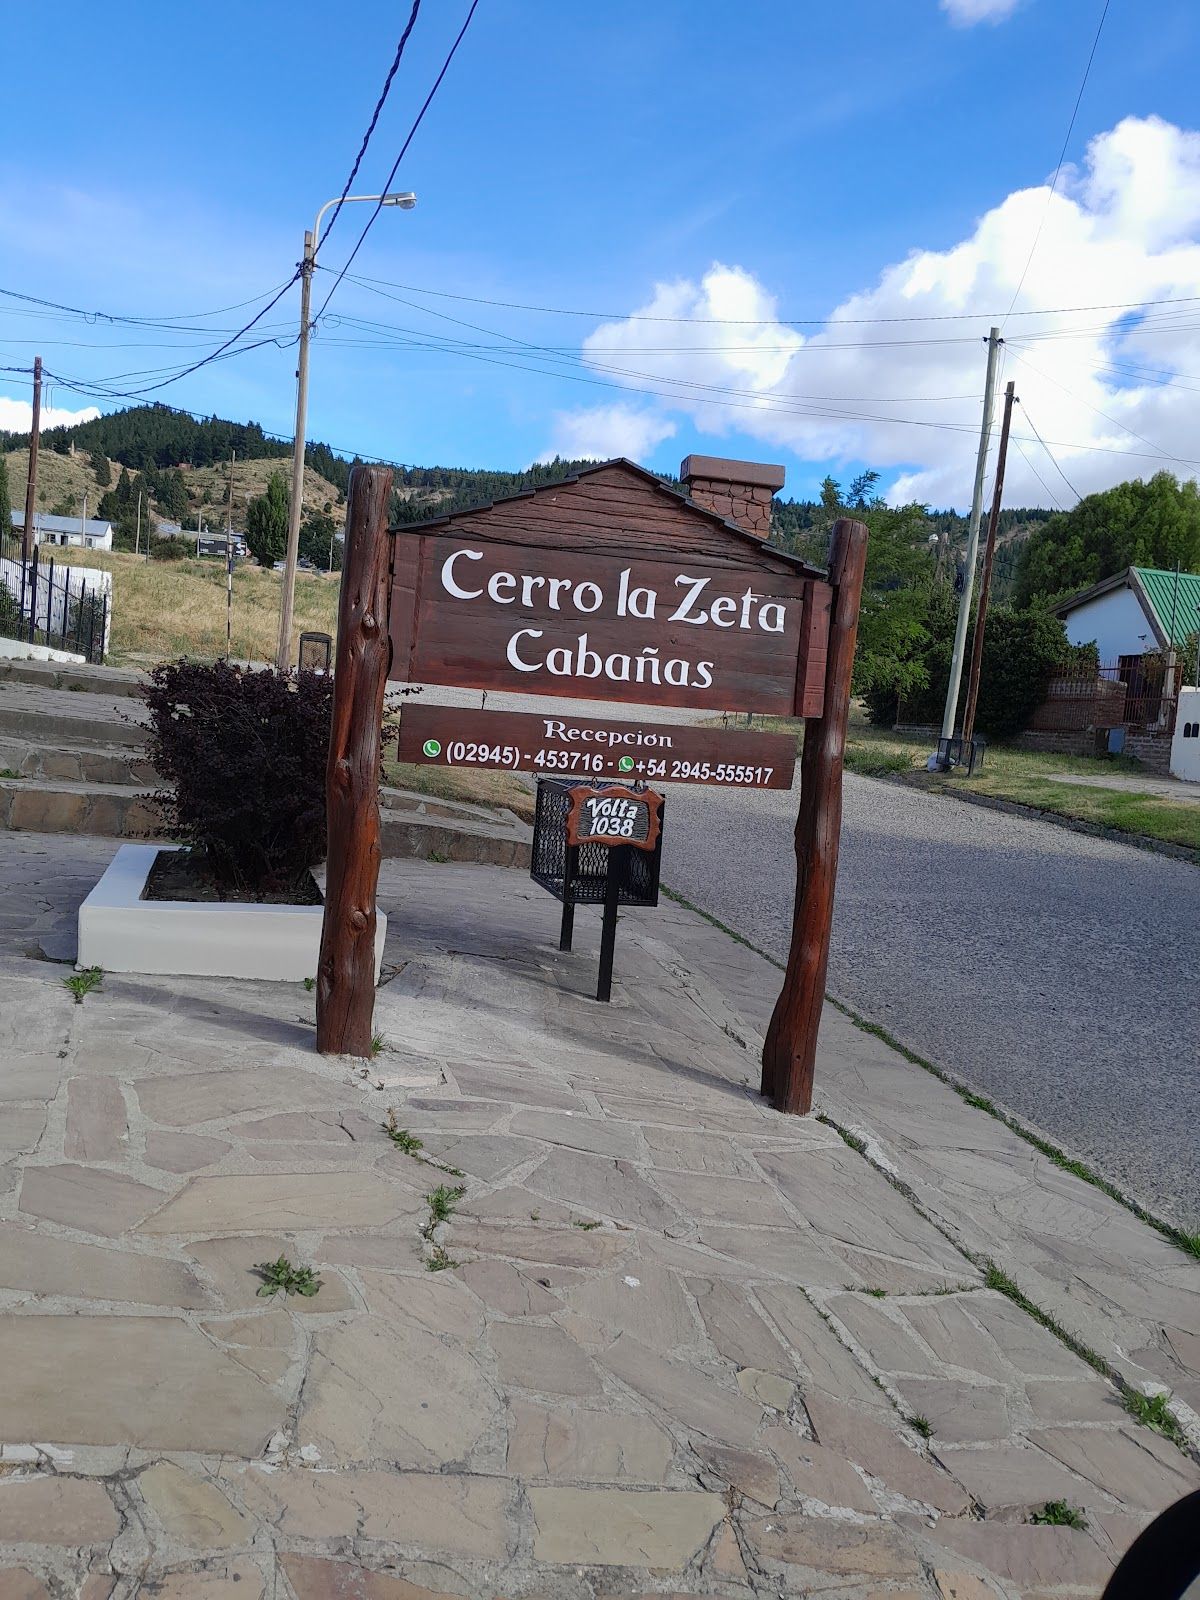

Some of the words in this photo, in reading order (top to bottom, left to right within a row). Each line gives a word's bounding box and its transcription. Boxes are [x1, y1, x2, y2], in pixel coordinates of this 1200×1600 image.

[441, 549, 603, 613] Cerro
[617, 568, 657, 619] la
[667, 574, 787, 633] Zeta
[506, 628, 714, 689] Cabañas
[543, 719, 673, 748] Recepción
[446, 741, 520, 769] (02945)
[534, 749, 604, 772] 453716
[635, 758, 667, 777] +54
[670, 760, 774, 784] 2945-555517
[586, 797, 638, 819] Volta
[589, 817, 635, 837] 1038
